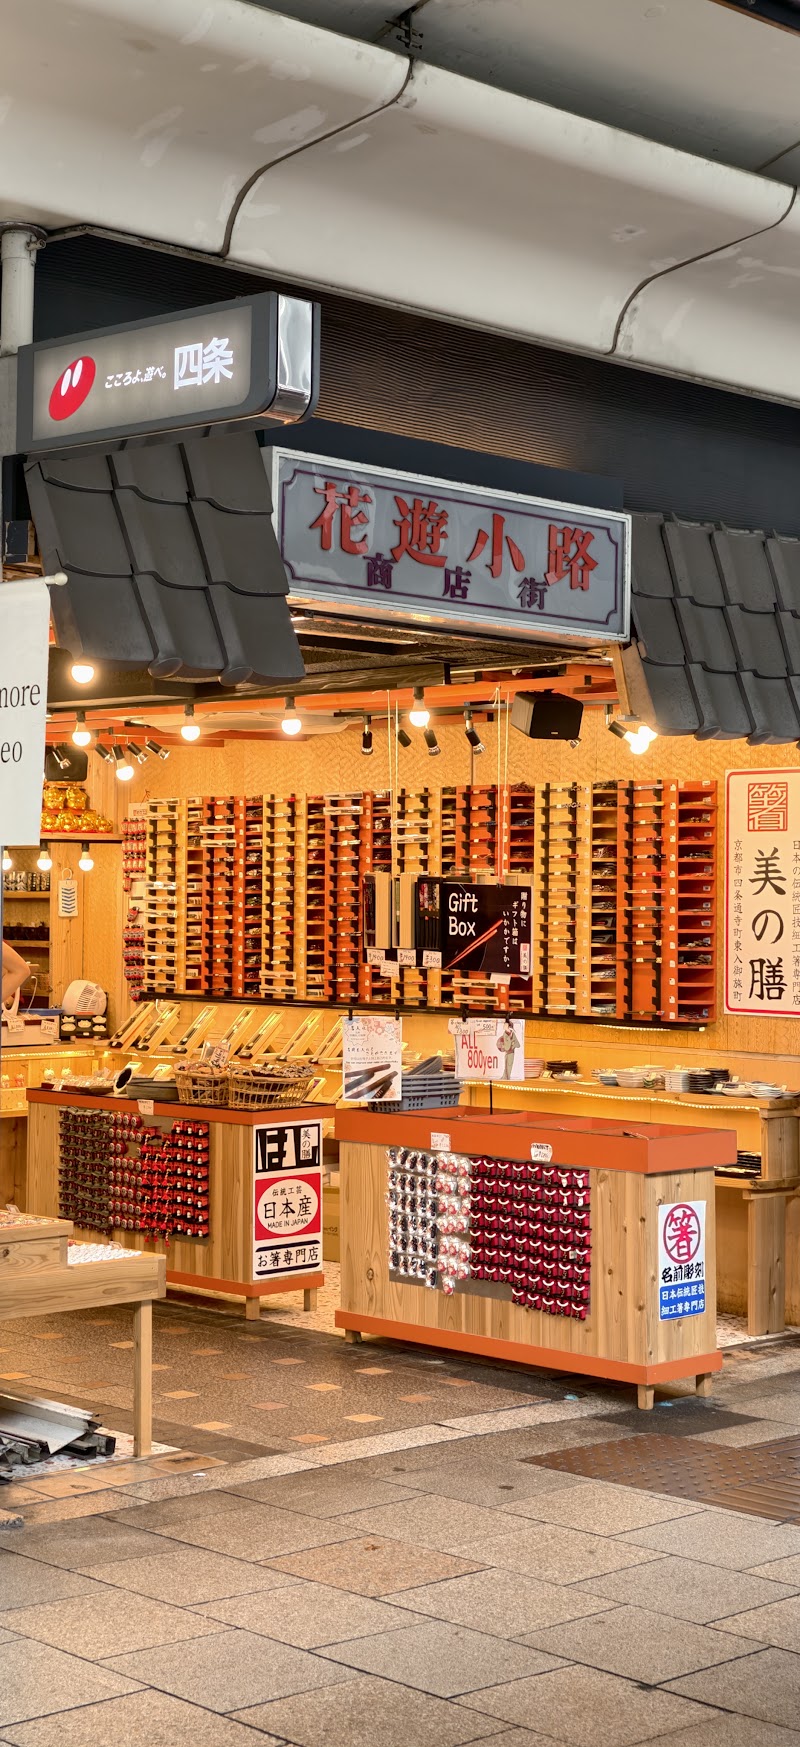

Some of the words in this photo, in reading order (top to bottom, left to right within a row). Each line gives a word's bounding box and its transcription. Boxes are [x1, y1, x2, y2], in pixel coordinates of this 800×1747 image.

[173, 337, 234, 390] 四条
[309, 481, 599, 591] 花遊小路
[363, 552, 548, 610] 商店街
[448, 892, 478, 913] Gift
[448, 915, 476, 937] Box
[511, 900, 519, 945] ギフト箱は
[732, 838, 743, 1002] 京都市四条通寺町東入御旅町
[748, 846, 788, 1001] 美の膳
[461, 1031, 478, 1050] ALL
[467, 1049, 499, 1075] 800yen
[301, 1128, 311, 1159] 美の膳
[272, 1185, 302, 1197] 伝統工芸
[263, 1195, 312, 1219] 日本産
[267, 1220, 283, 1229] MADE
[291, 1218, 309, 1227] JAPAN
[667, 1210, 698, 1258] 箸
[257, 1246, 319, 1267] お箸専門店
[661, 1261, 704, 1284] 名前彫刻
[661, 1283, 705, 1301] 日本伝統匠技
[661, 1299, 705, 1317] 細工箸専門店
